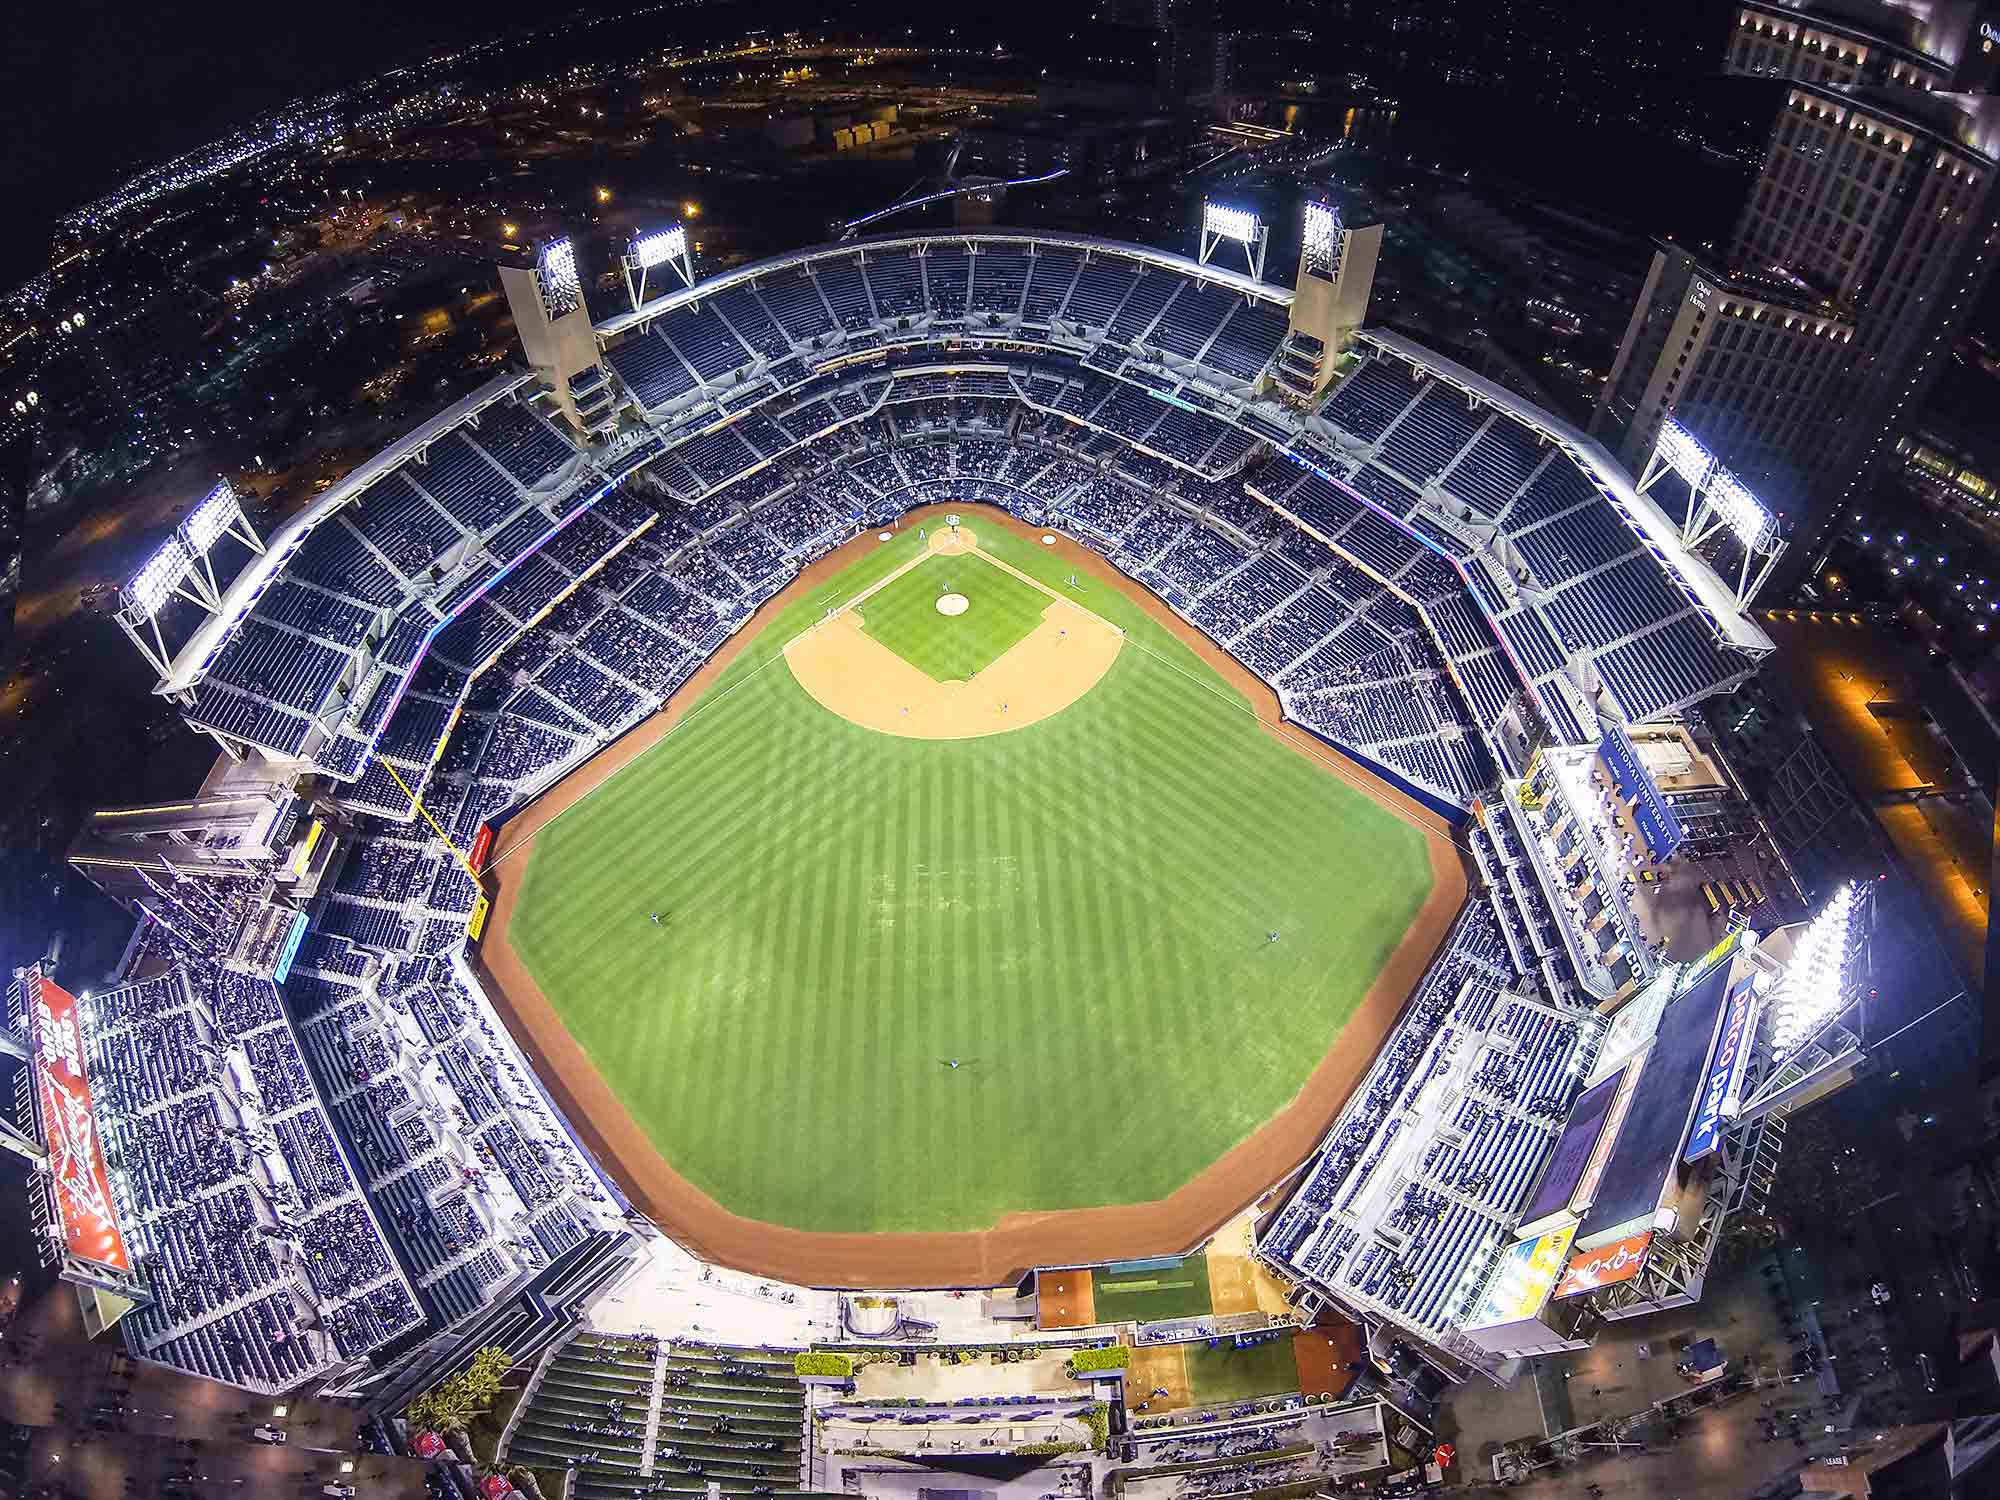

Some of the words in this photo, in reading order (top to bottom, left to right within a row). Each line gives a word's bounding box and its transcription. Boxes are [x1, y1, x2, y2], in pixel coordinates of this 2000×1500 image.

[1607, 757, 1621, 779] nu.edu
[1609, 729, 1639, 783] NATIONAL
[1638, 781, 1675, 845] UNIVERSITY
[1641, 821, 1655, 845] nu.edu
[1571, 825, 1600, 877] METAL
[1596, 880, 1630, 944] SUPPLY
[1719, 988, 1750, 1068] petco
[1696, 1068, 1730, 1140] park
